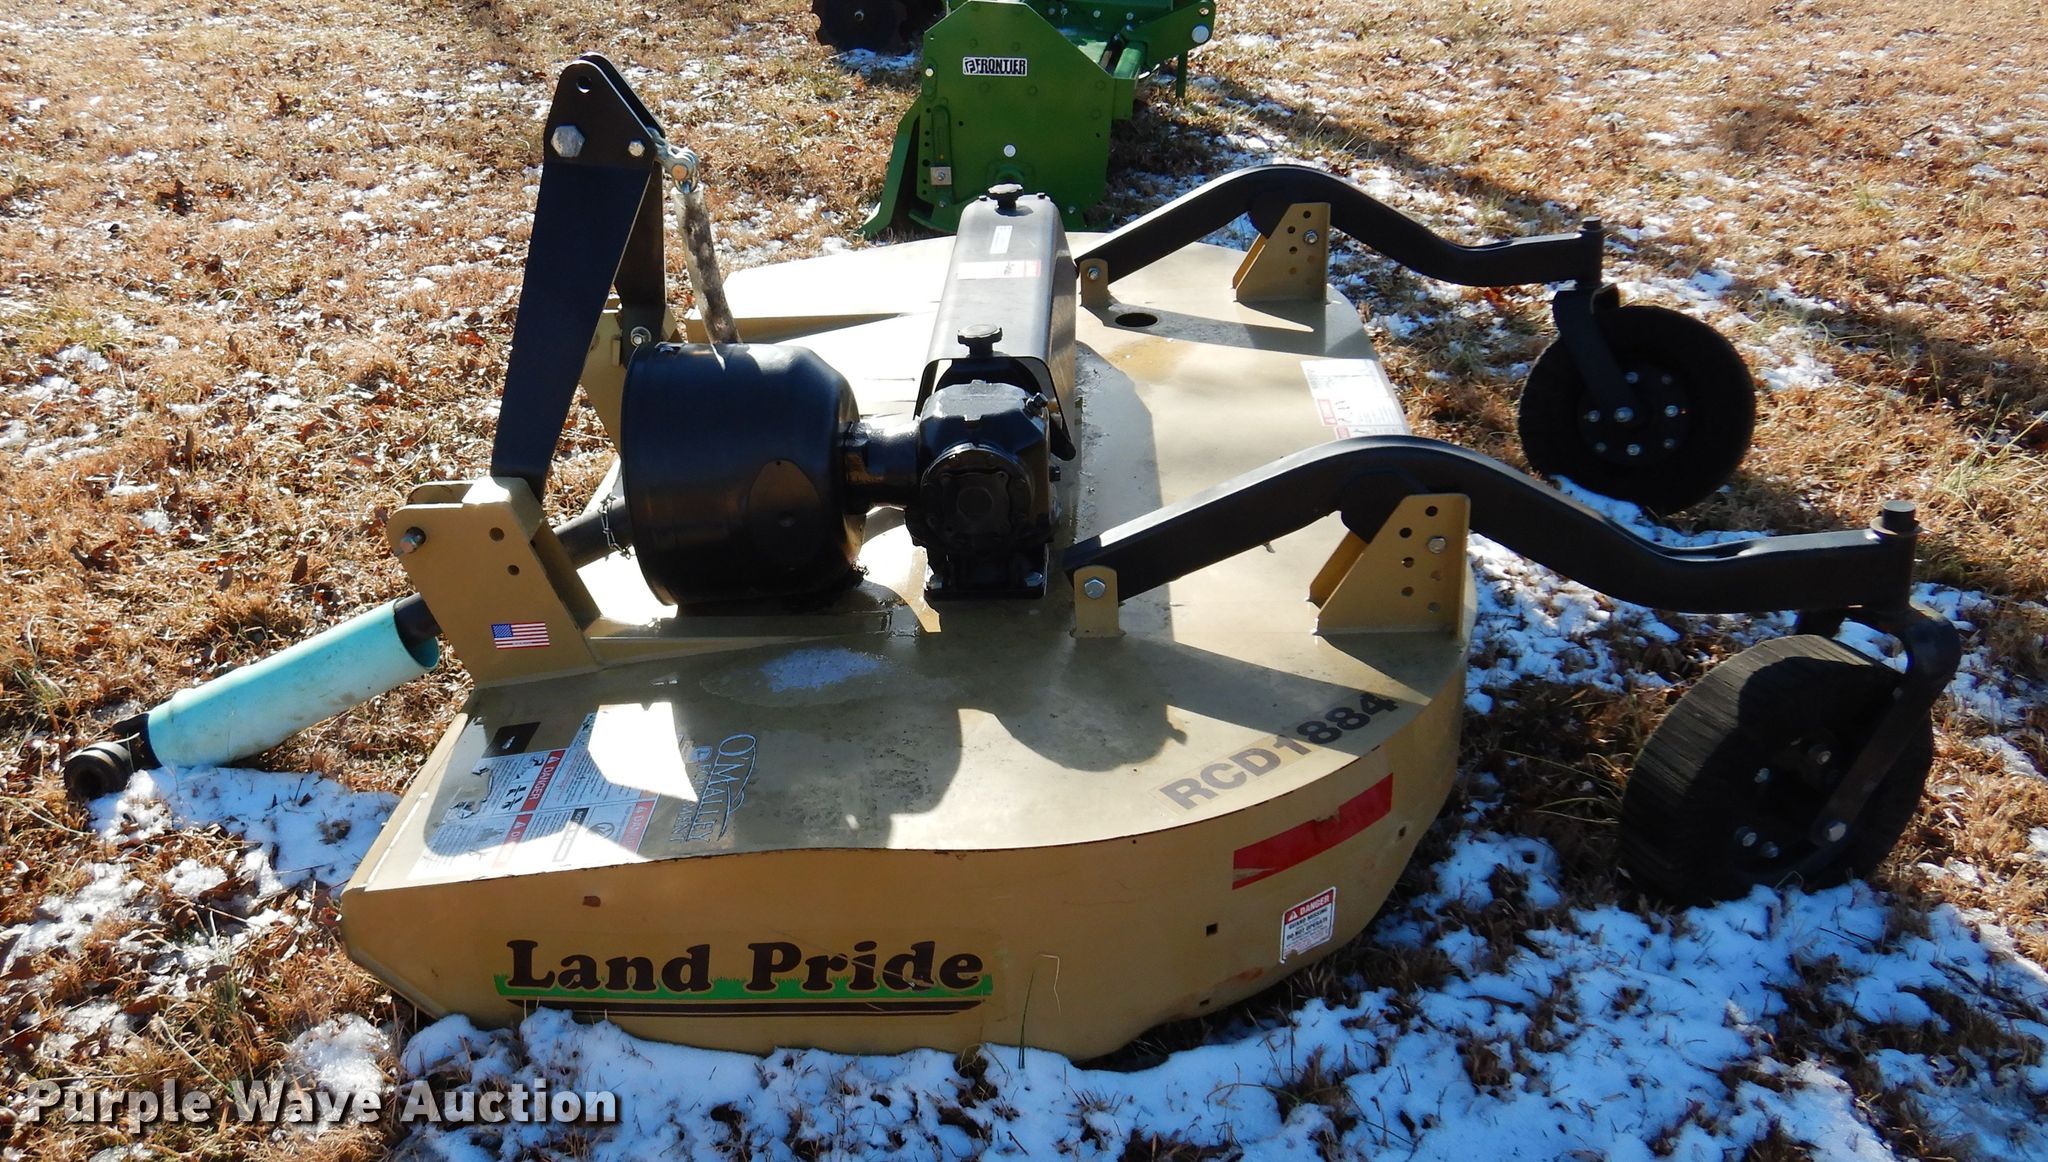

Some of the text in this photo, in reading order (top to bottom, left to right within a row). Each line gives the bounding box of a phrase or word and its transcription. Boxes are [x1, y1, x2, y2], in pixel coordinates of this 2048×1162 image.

[975, 59, 1026, 75] FRONTIER
[1160, 692, 1399, 810] RCD1884
[529, 766, 556, 801] DANGER
[1300, 894, 1330, 915] DANGER
[506, 940, 984, 992] Land Pride
